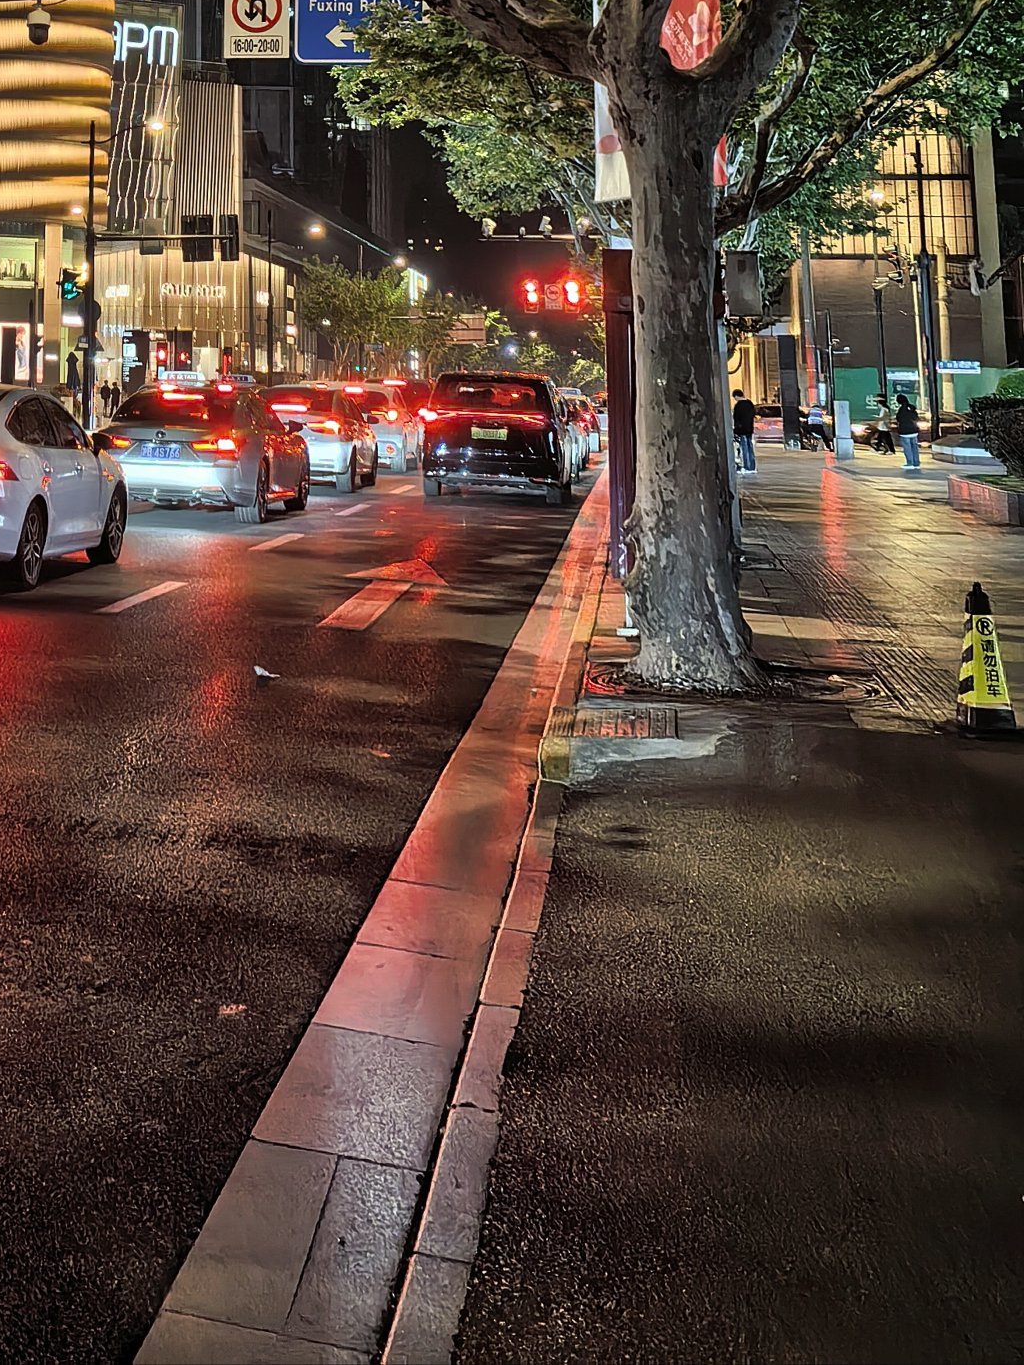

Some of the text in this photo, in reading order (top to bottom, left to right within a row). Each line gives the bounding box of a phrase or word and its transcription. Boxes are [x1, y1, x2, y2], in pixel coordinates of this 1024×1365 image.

[309, 0, 353, 15] Fuxing
[232, 38, 280, 53] 16:00-20:00
[981, 639, 1002, 697] 请勿泊车
